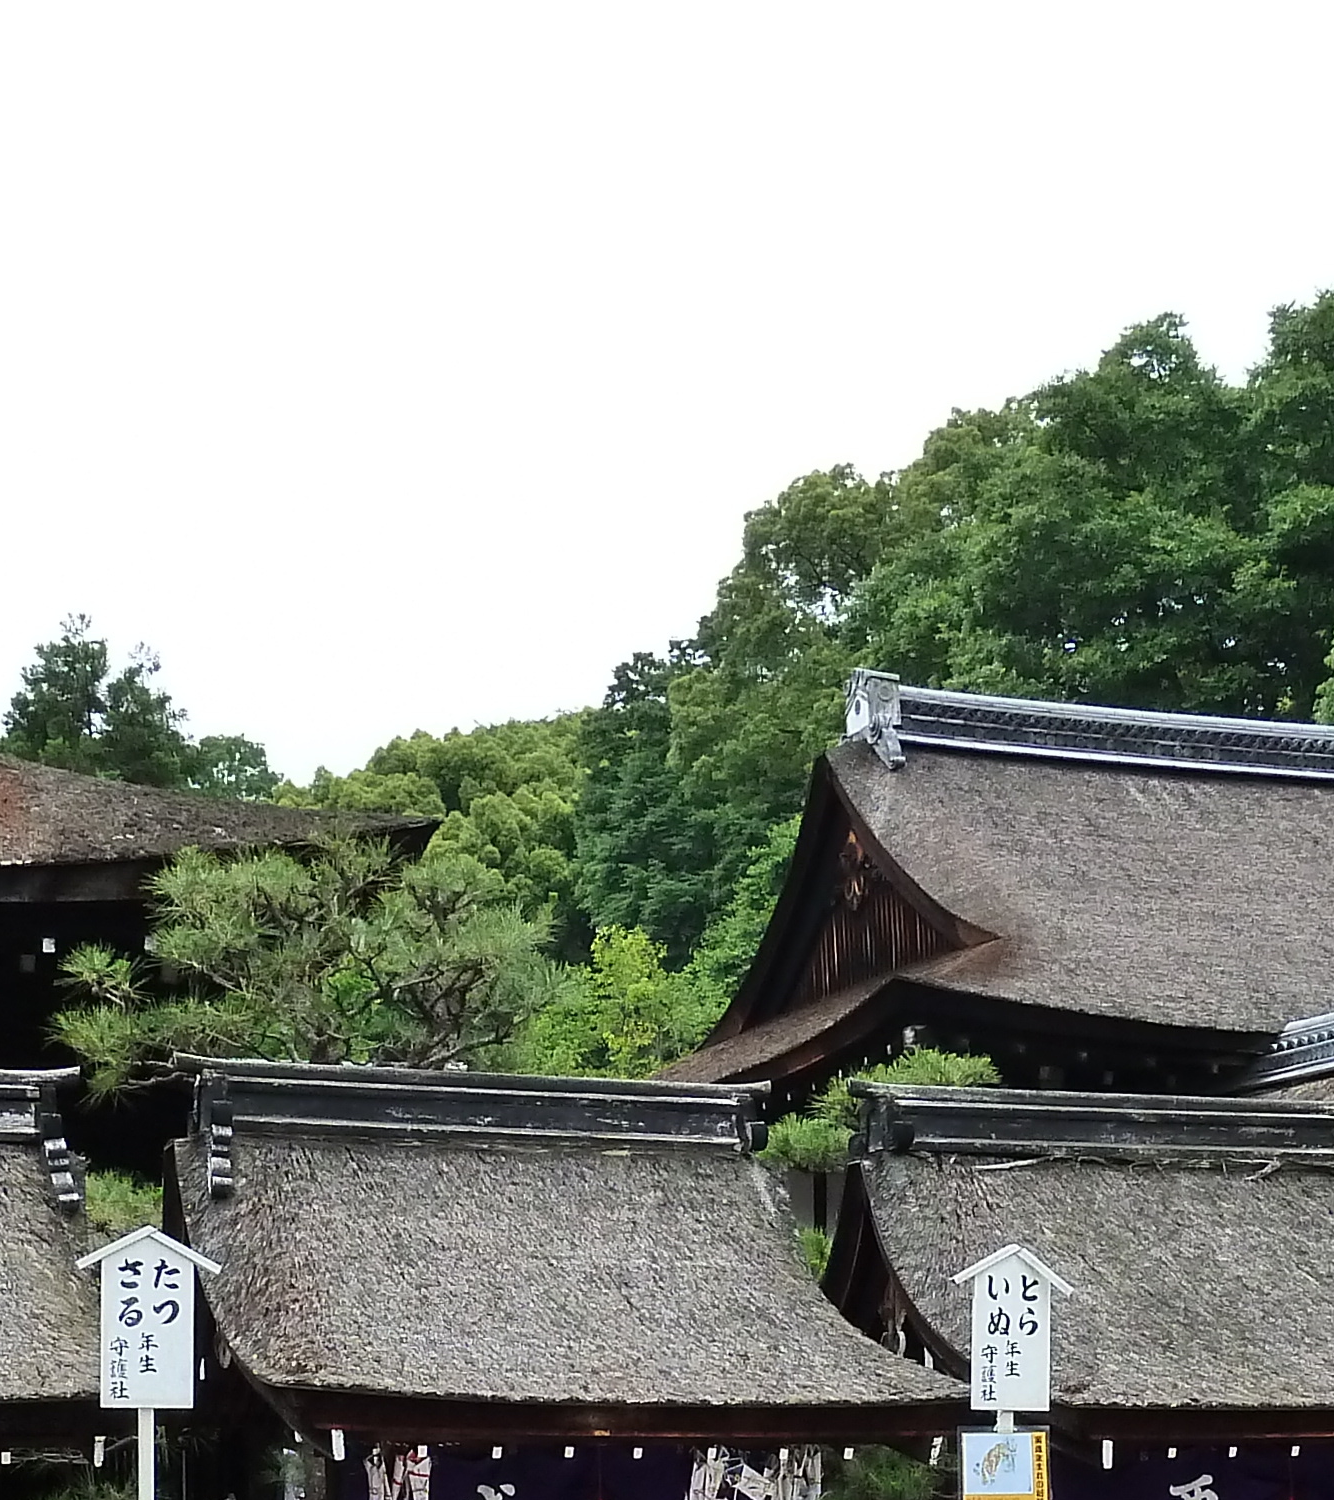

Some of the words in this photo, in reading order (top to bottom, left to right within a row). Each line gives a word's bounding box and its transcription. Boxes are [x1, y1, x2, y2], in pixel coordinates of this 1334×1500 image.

[117, 1258, 145, 1328] さる
[152, 1258, 181, 1325] たつ
[987, 1274, 1011, 1336] いぬ
[1018, 1274, 1040, 1336] とら
[109, 1336, 130, 1400] 守護社
[137, 1332, 160, 1374] 年生
[980, 1343, 998, 1401] 守護社
[1004, 1339, 1022, 1378] 年生
